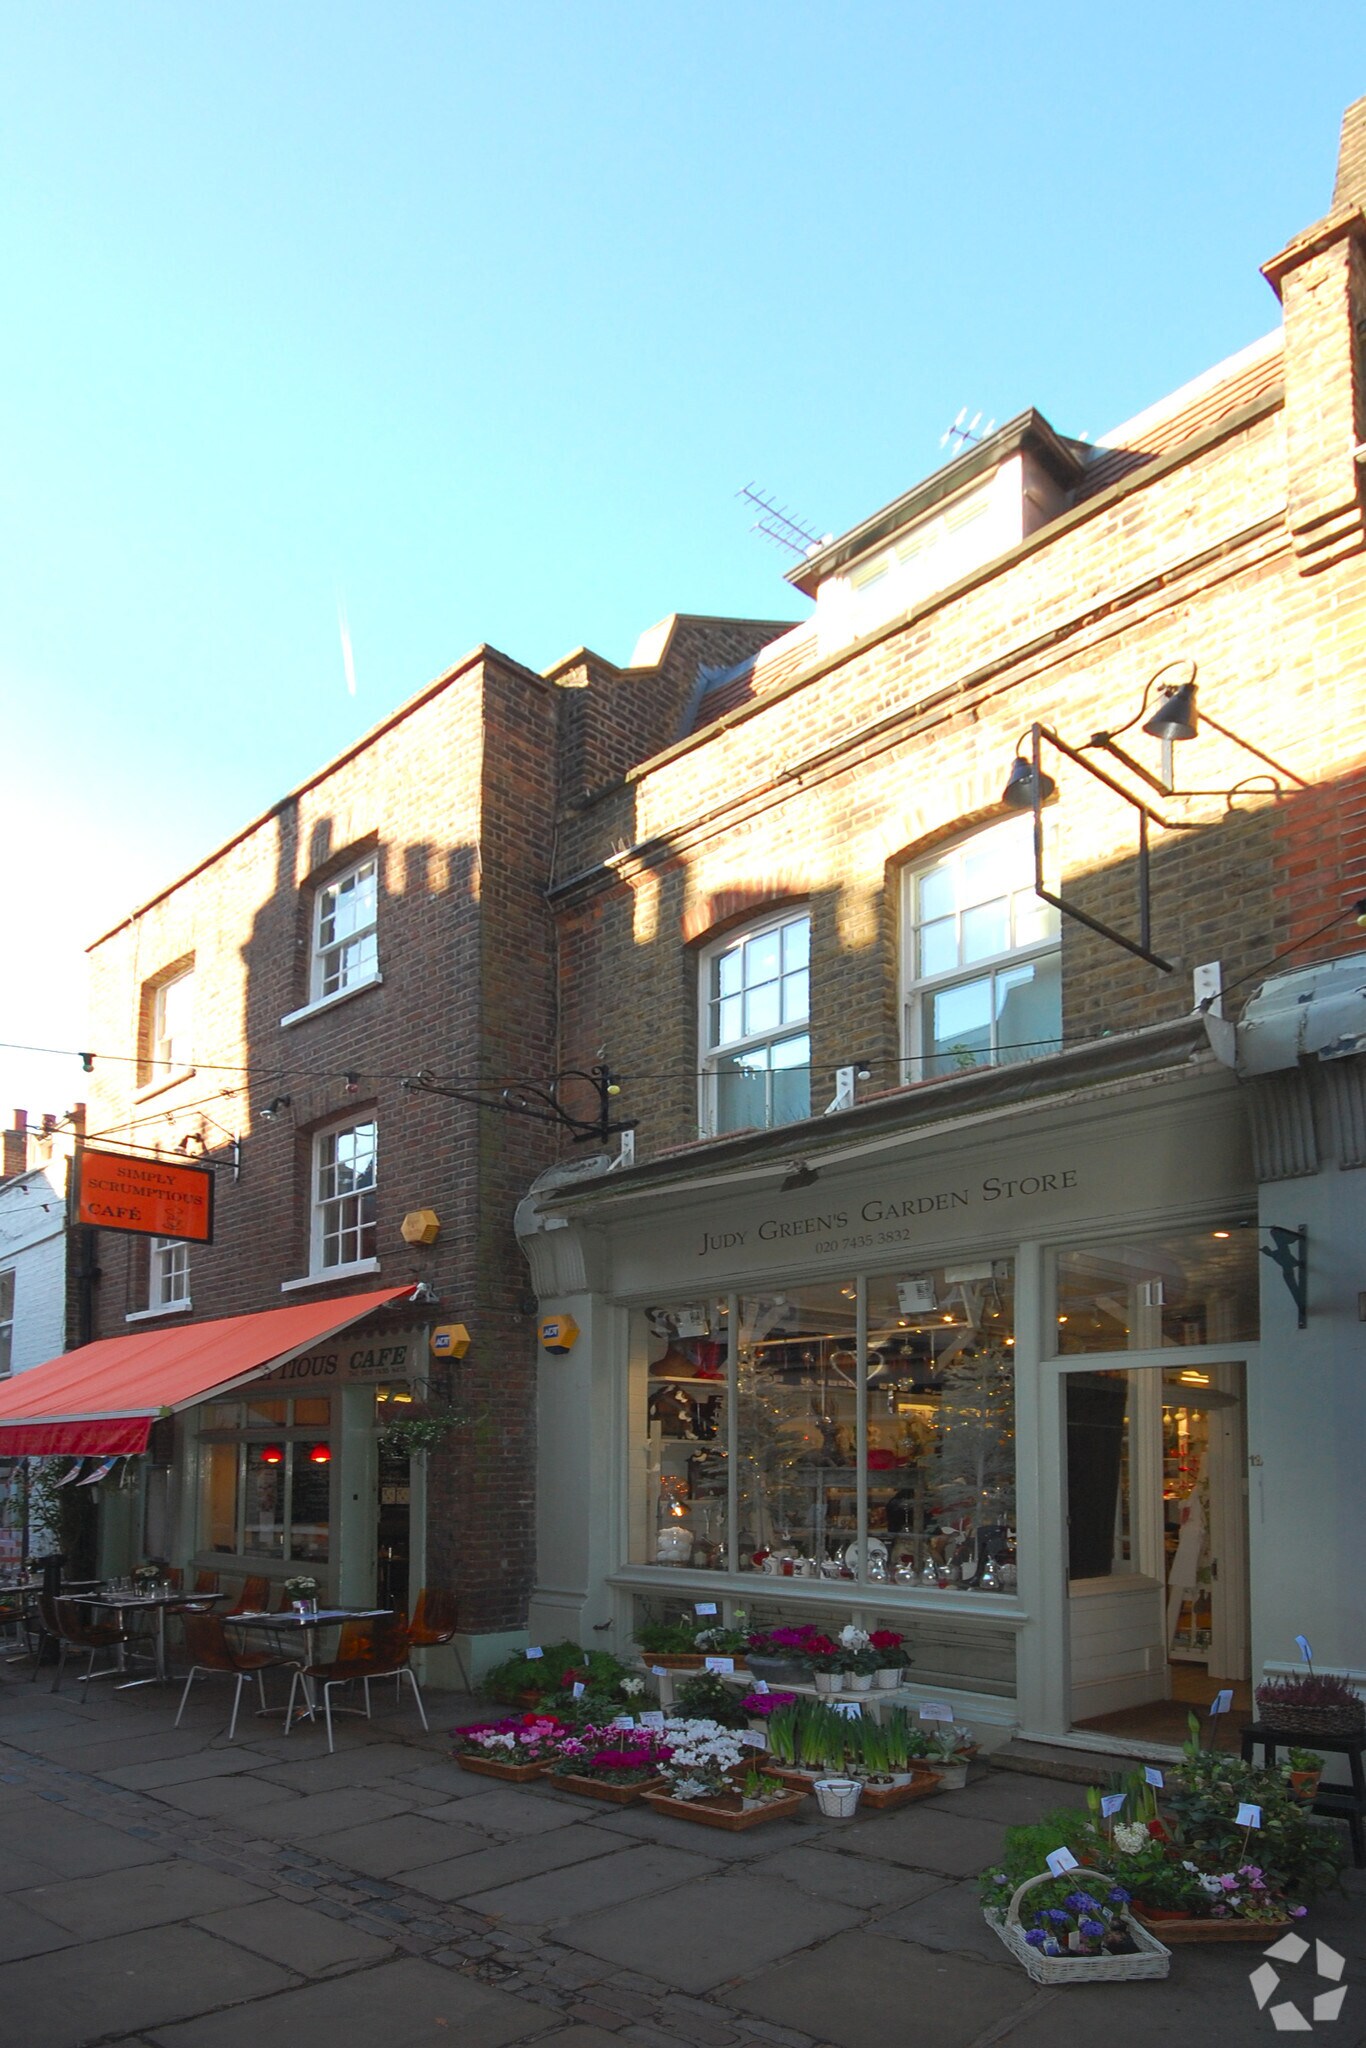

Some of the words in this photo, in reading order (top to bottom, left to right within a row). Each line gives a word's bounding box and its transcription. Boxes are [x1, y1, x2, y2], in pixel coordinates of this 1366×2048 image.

[117, 1167, 177, 1186] SIMPLY
[88, 1178, 203, 1205] SCRUMPTIOUS
[88, 1202, 142, 1221] CAFÉ
[699, 1231, 748, 1256] JUDY
[758, 1212, 848, 1240] GREEN'S
[861, 1189, 969, 1222] GARDEN
[982, 1169, 1078, 1201] STORE
[815, 1240, 838, 1254] 020
[841, 1234, 873, 1249] 7435
[877, 1228, 910, 1245] 3832
[1144, 1280, 1167, 1306] 11
